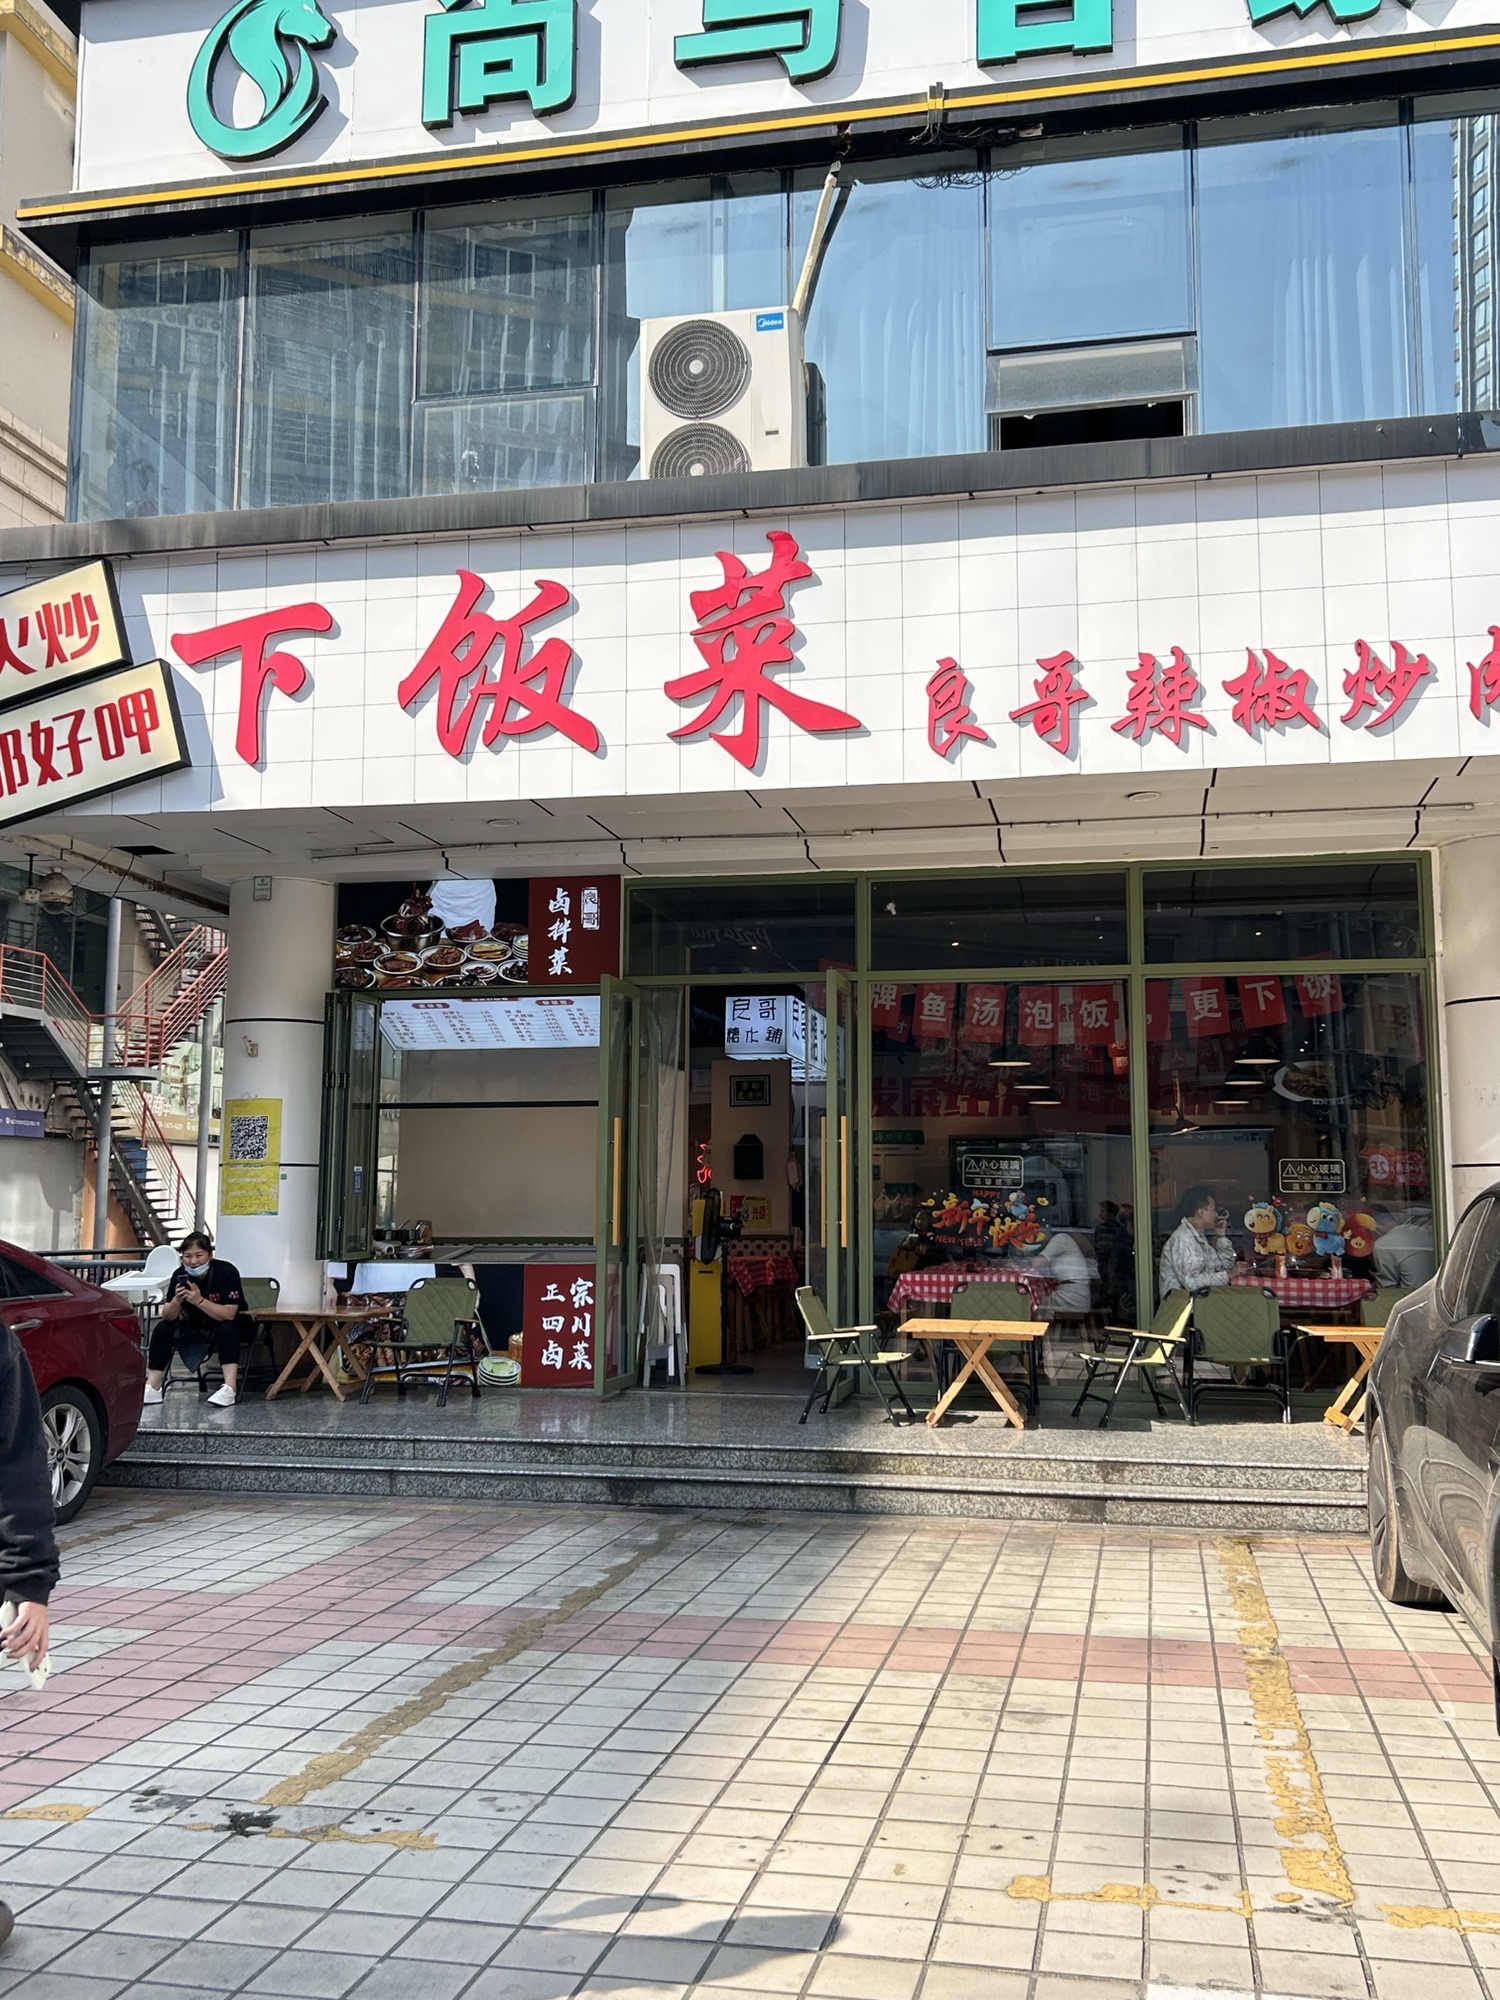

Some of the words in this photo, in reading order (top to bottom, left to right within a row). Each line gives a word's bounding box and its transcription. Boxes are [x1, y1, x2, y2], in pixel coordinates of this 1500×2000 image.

[761, 318, 782, 327] Midea
[172, 531, 862, 770] 下饭菜
[731, 997, 777, 1022] 良哥
[978, 1159, 1020, 1170] 小心玻璃
[1296, 1163, 1341, 1174] 小心玻璃
[972, 1190, 1001, 1199] HAPPY
[935, 1235, 956, 1244] NEW
